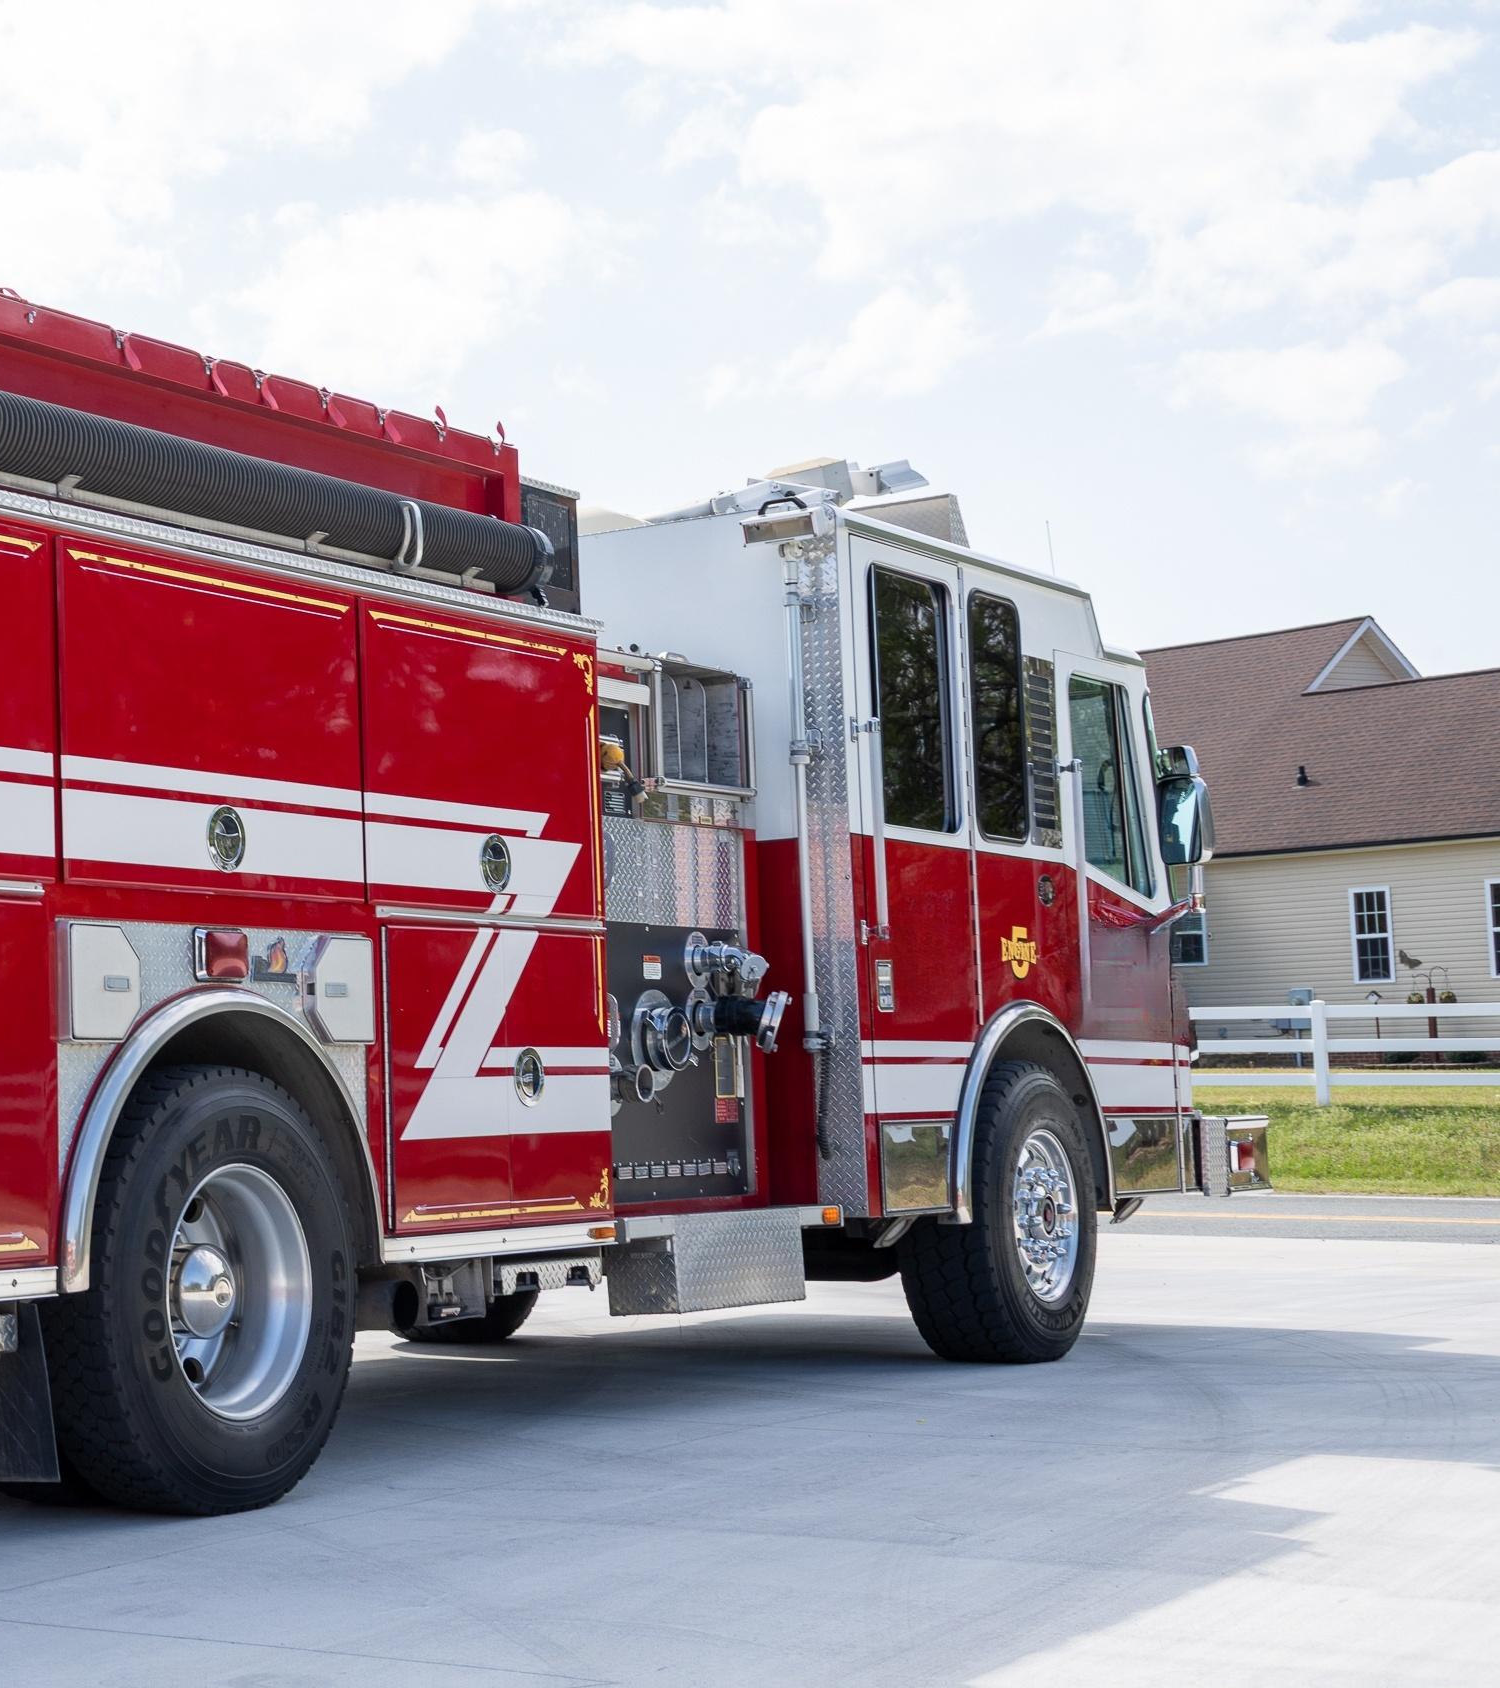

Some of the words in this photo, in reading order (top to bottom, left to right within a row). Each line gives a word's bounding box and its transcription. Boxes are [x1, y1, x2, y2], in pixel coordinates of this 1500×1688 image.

[1000, 936, 1037, 964] ENGINE
[141, 1114, 261, 1383] GOODYEAR
[1024, 1293, 1073, 1330] MICHELIN
